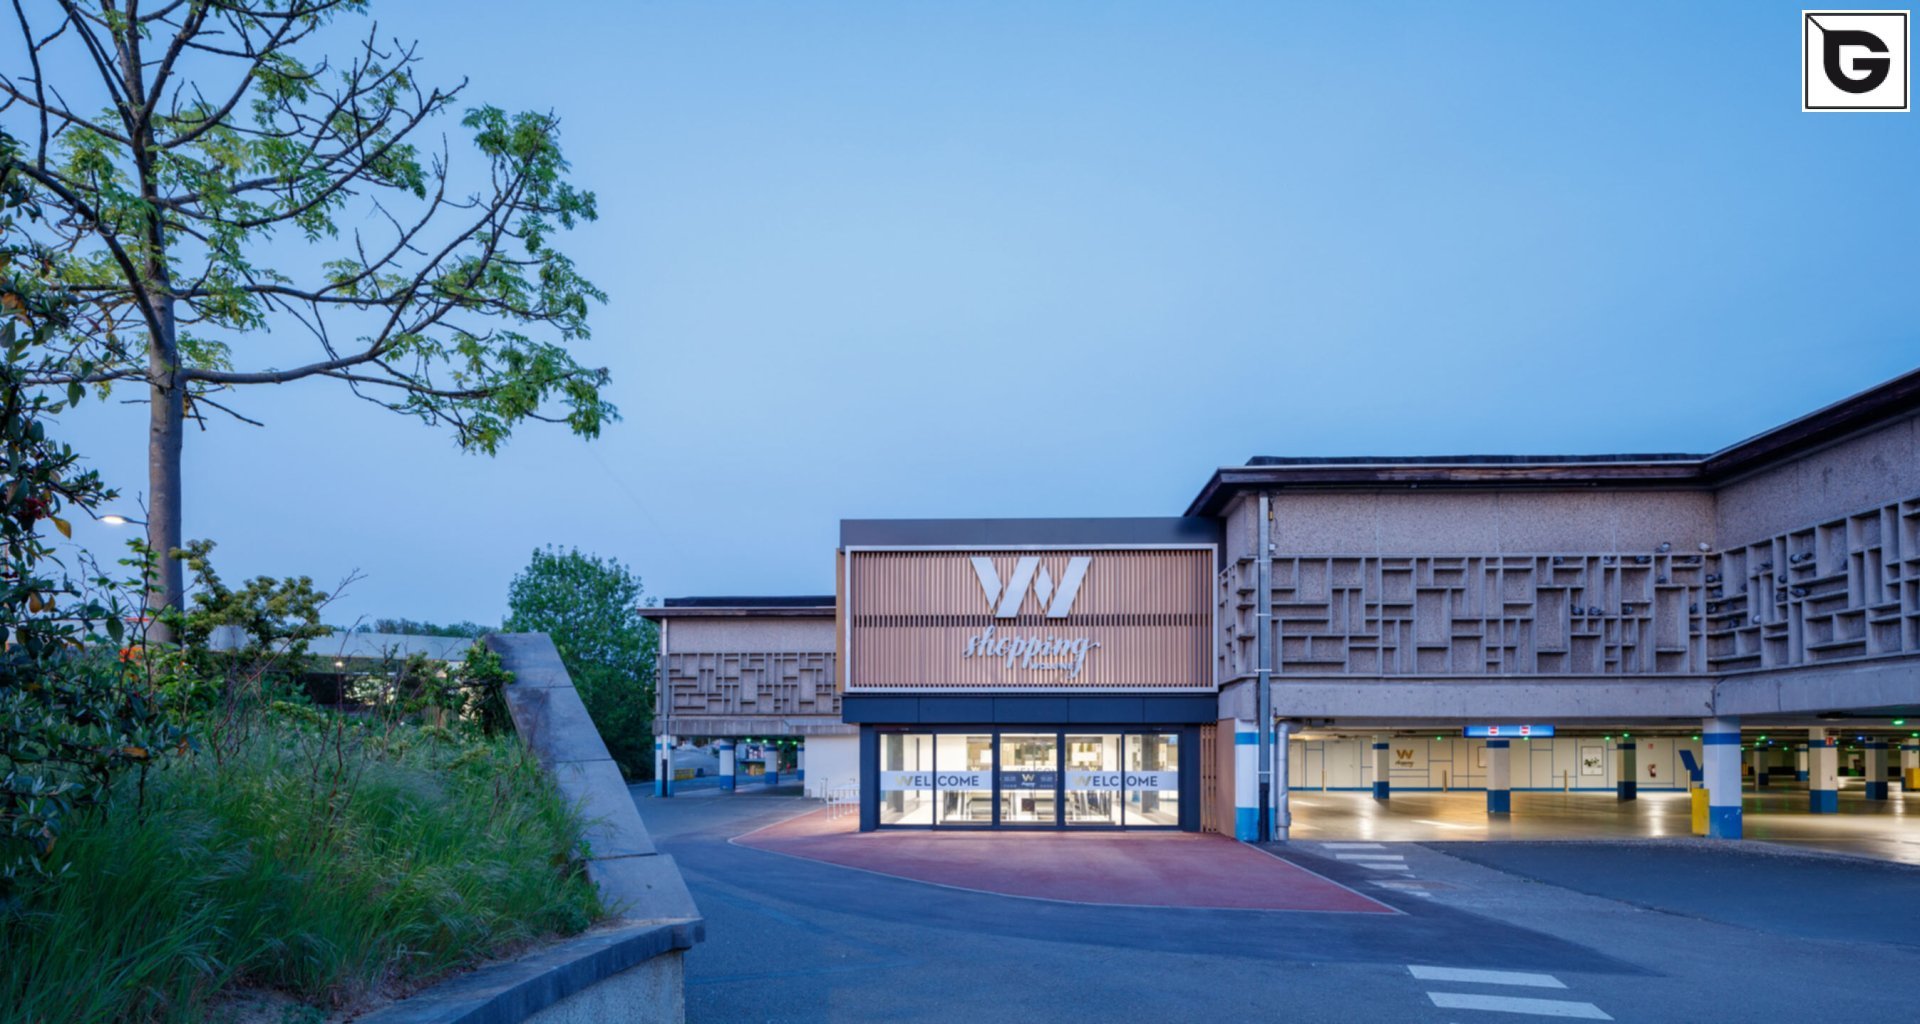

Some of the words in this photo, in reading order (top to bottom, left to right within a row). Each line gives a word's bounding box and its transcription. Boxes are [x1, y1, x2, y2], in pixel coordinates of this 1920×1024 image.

[963, 624, 1101, 680] shopping
[895, 775, 980, 787] WELCOME
[1073, 775, 1159, 787] WELCOME
